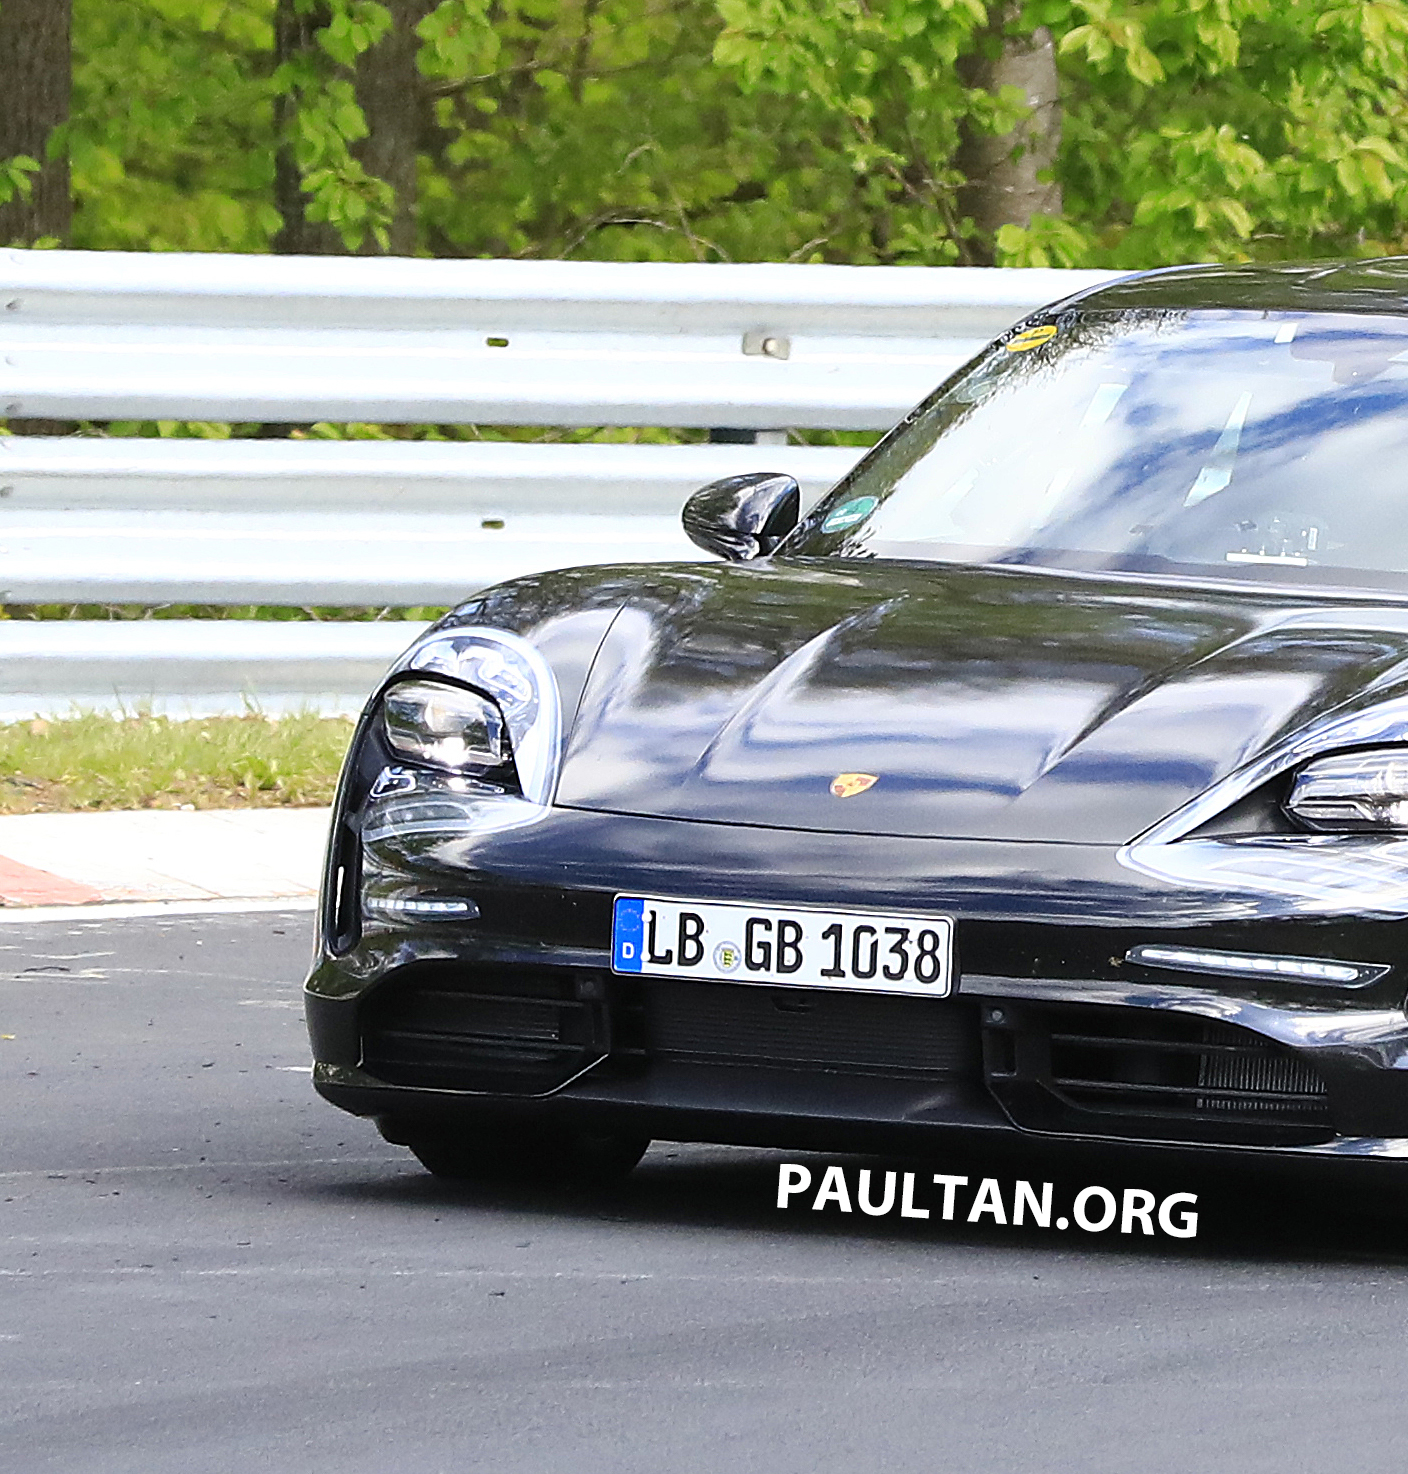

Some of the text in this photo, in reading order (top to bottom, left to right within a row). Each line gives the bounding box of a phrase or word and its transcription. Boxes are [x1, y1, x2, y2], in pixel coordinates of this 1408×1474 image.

[622, 942, 635, 959] D
[647, 910, 941, 984] LB GB 1038
